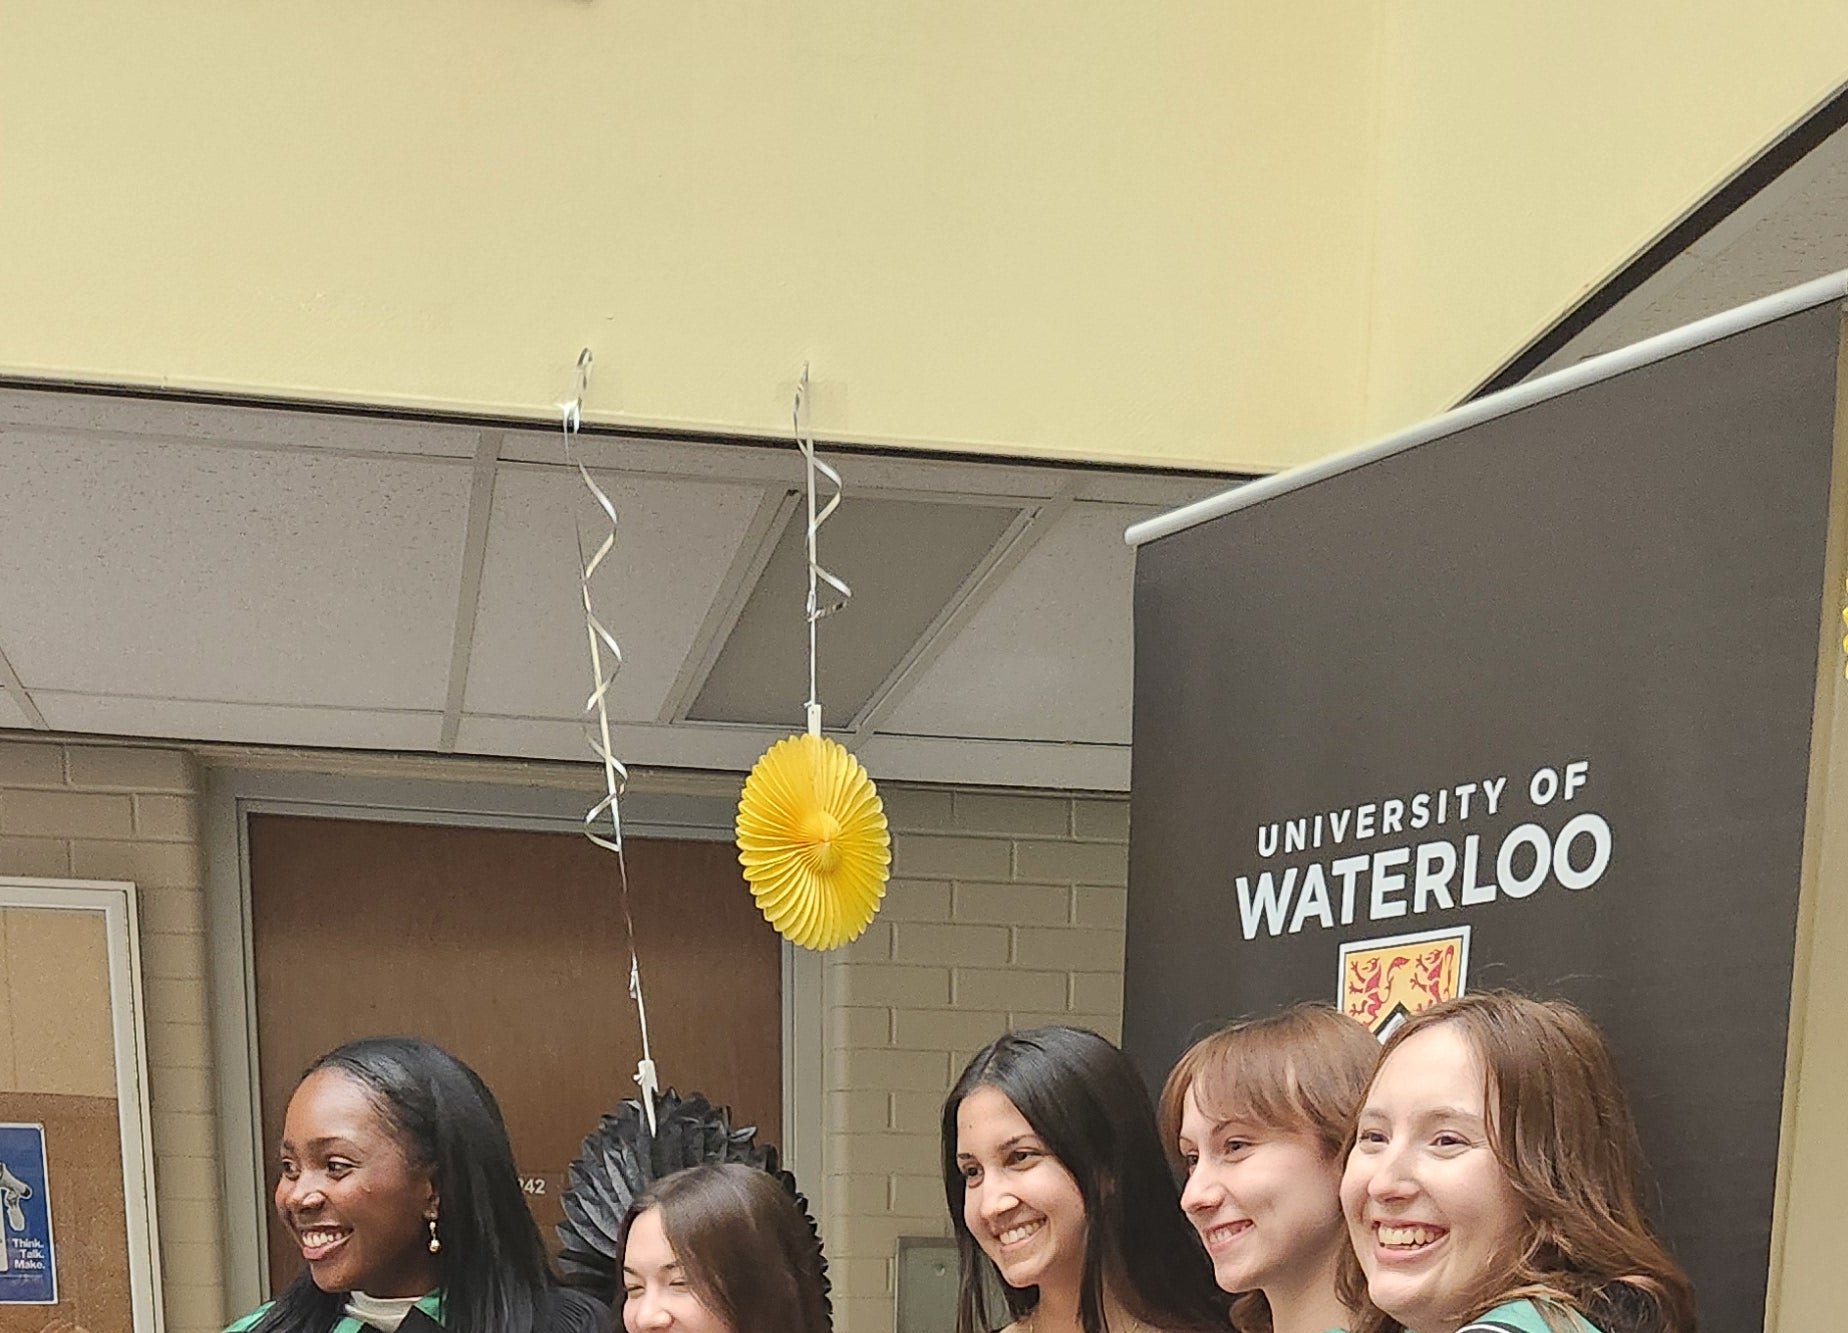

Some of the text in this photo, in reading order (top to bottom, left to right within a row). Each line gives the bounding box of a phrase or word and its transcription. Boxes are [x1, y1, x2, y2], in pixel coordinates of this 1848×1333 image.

[1257, 760, 1590, 858] UNIVERSITY OF
[1234, 812, 1613, 941] WATERLOO
[12, 1238, 45, 1248] Think.
[19, 1248, 45, 1259] Talk.
[14, 1259, 46, 1270] Make.
